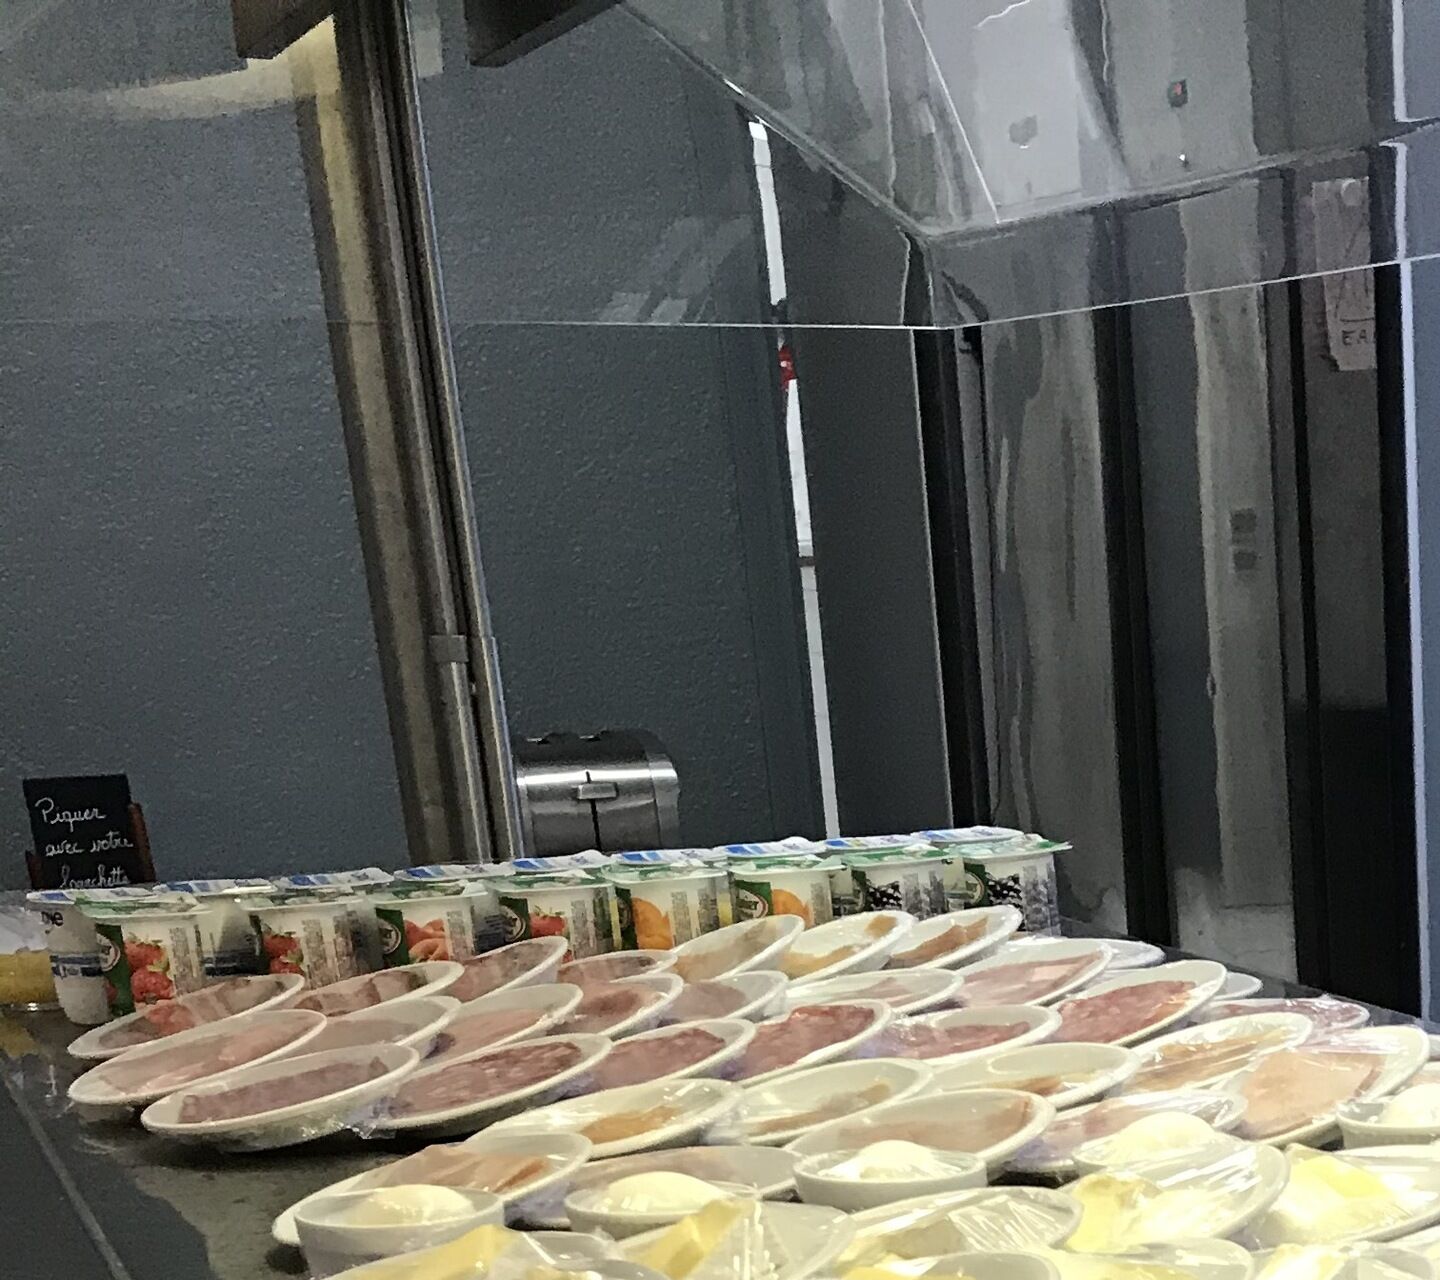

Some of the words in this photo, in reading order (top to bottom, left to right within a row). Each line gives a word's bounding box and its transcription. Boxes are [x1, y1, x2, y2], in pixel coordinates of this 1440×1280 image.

[34, 797, 107, 832] Piquer
[45, 839, 84, 857] avec
[89, 830, 134, 853] votre
